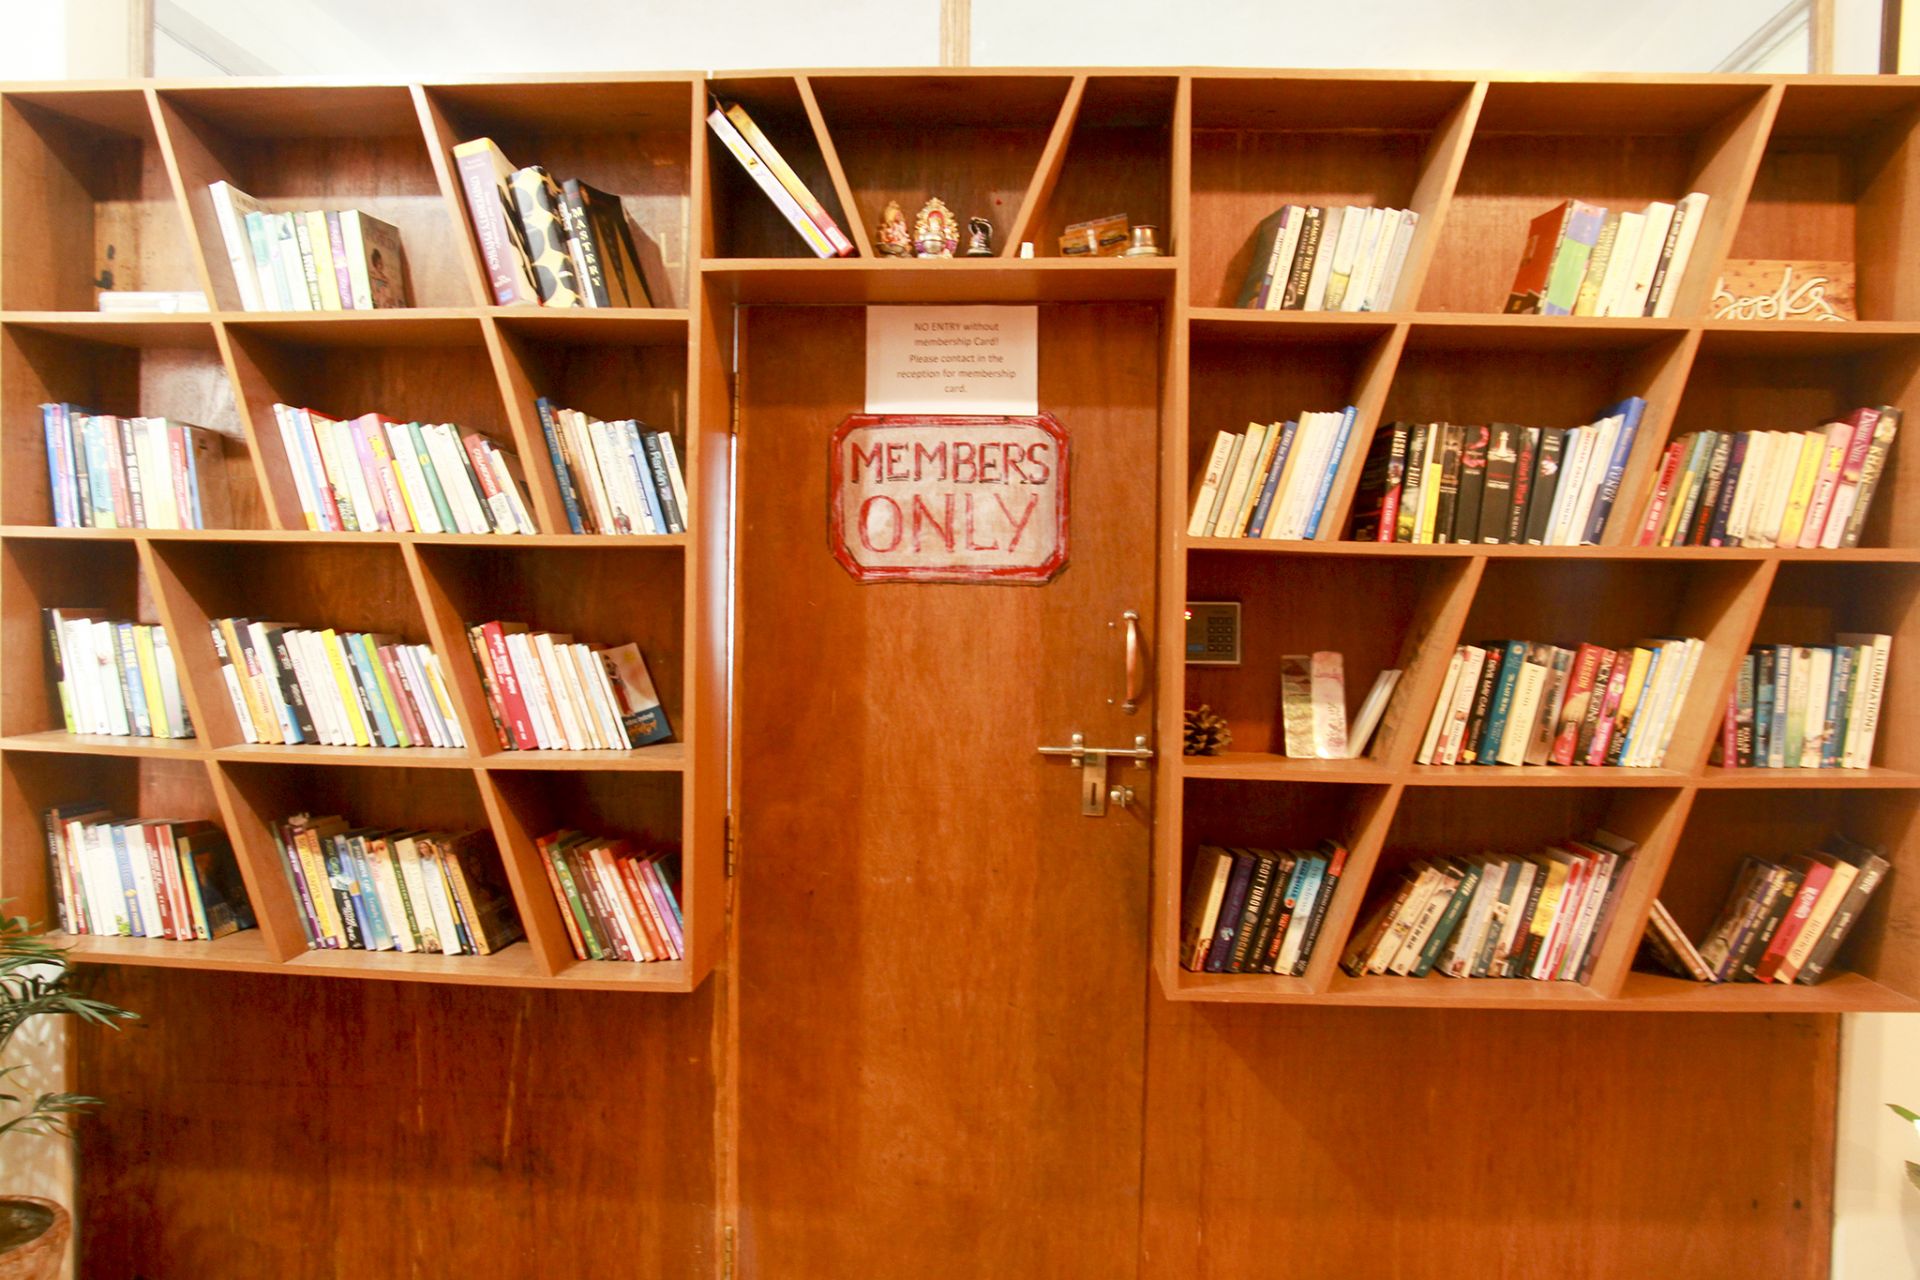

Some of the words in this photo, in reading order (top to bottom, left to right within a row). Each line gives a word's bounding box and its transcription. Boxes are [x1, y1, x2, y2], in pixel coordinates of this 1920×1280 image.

[571, 207, 600, 287] MASTERY
[1296, 271, 1308, 295] WITCH
[914, 322, 930, 331] NO
[931, 322, 960, 331] ENTRY
[962, 322, 999, 331] without
[914, 337, 972, 346] membership
[909, 354, 938, 363] Please
[940, 354, 975, 362] contact
[977, 354, 986, 362] in
[988, 354, 1004, 362] the
[896, 370, 940, 379] reception
[942, 369, 956, 378] for
[958, 370, 1016, 379] membership
[944, 385, 967, 393] card.
[1391, 430, 1406, 457] MESSI
[850, 441, 1050, 485] MEMBERS
[1860, 444, 1883, 485] KHAN
[858, 492, 1039, 553] ONLY
[1576, 648, 1597, 689] LARSSON
[1596, 655, 1613, 683] JACK
[1584, 682, 1605, 723] HIGGINS
[1863, 648, 1885, 733] ILLUMINATIONS
[1255, 857, 1273, 885] SCOTT
[1246, 884, 1266, 914] TUROW
[1233, 921, 1253, 962] INNOCENT
